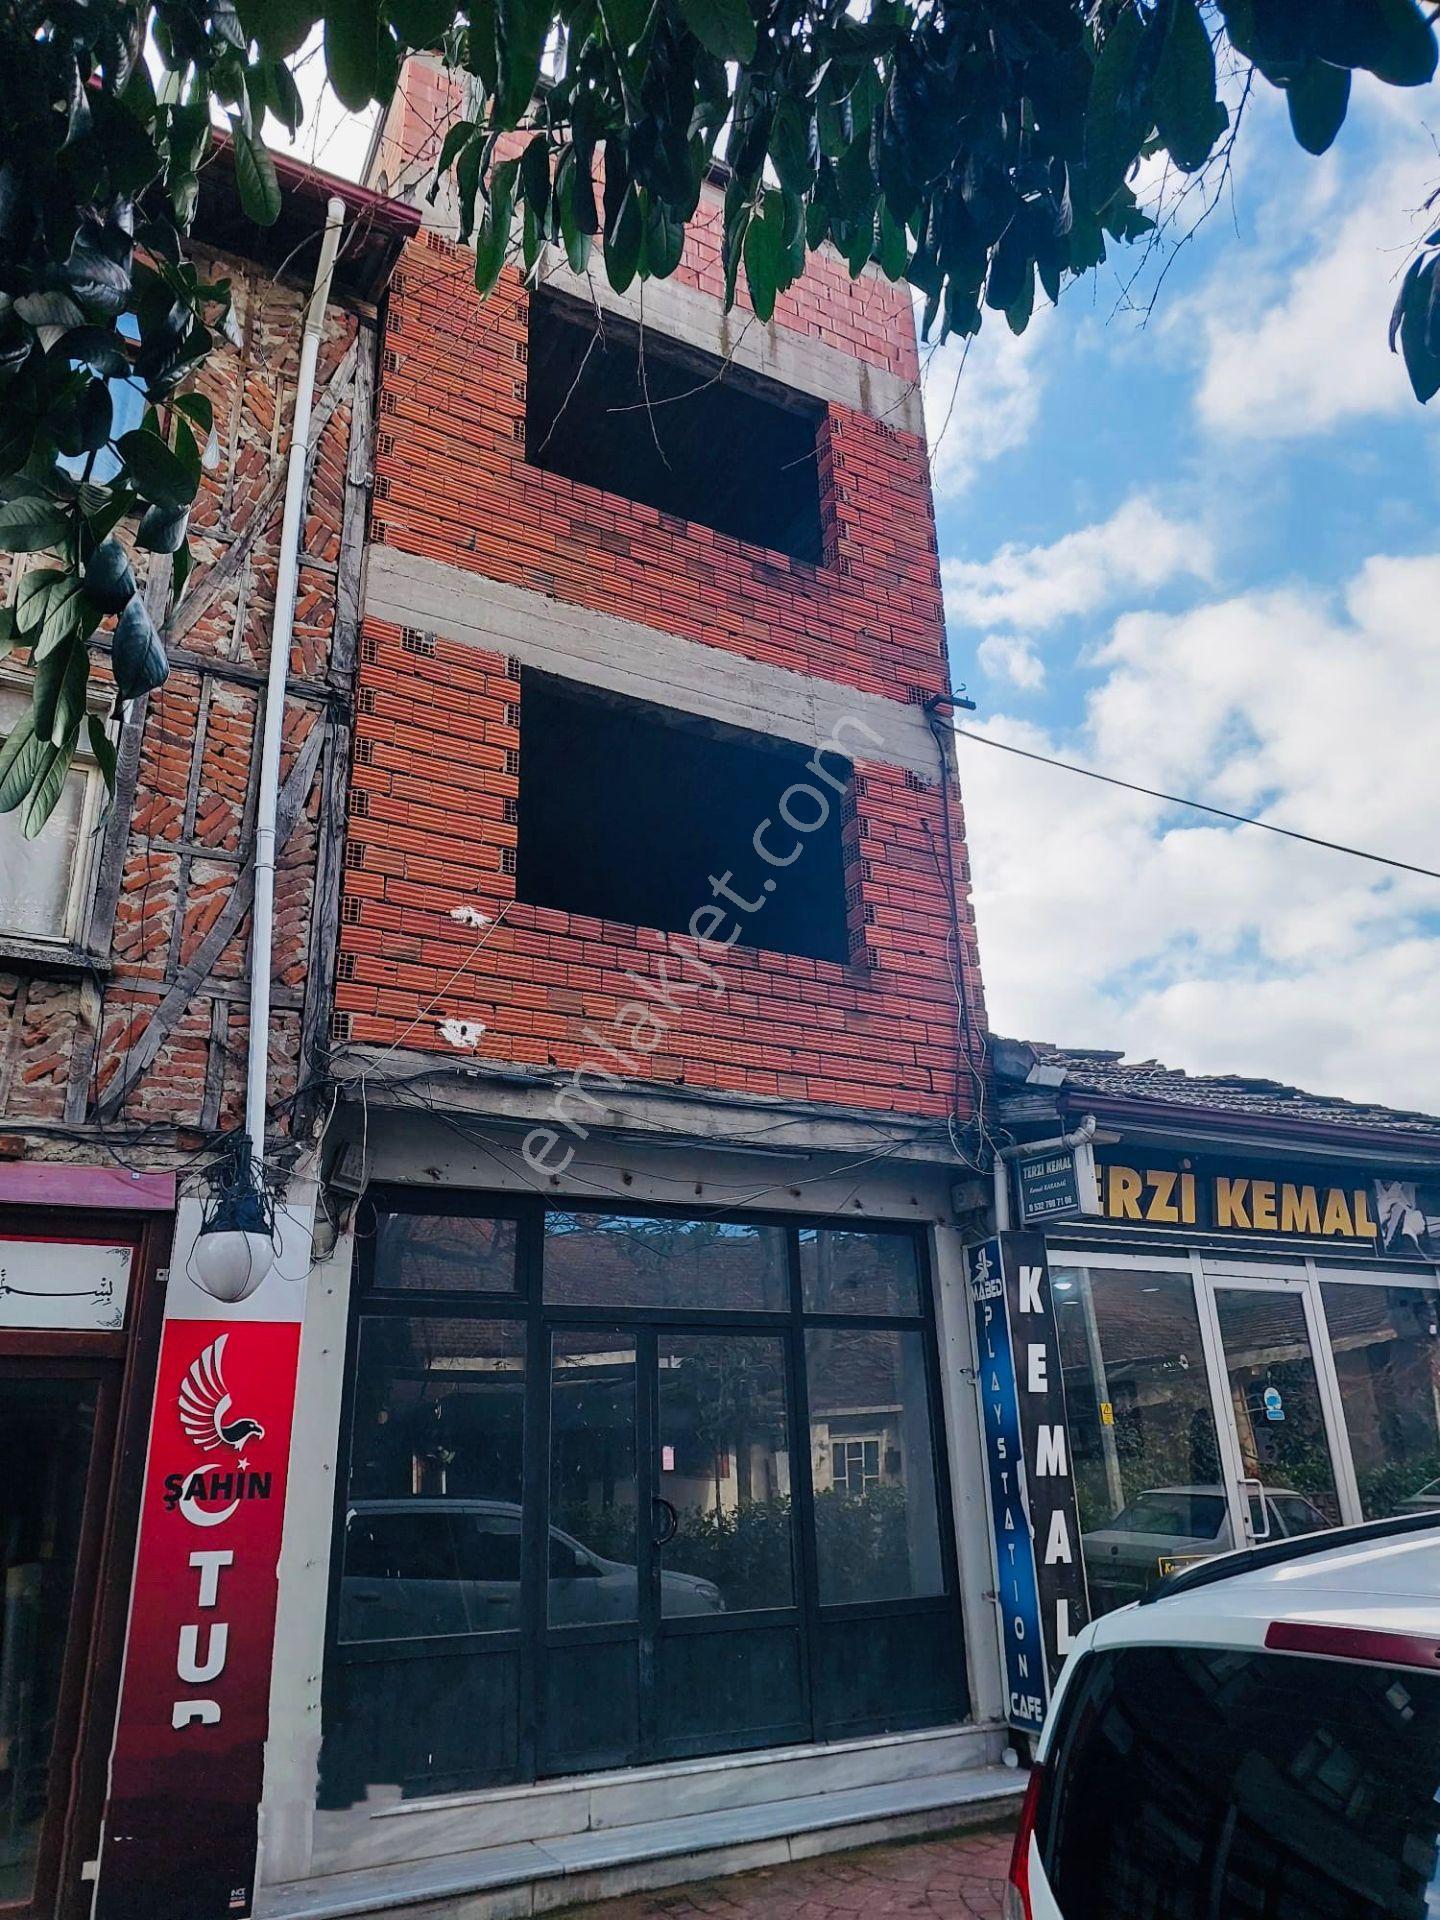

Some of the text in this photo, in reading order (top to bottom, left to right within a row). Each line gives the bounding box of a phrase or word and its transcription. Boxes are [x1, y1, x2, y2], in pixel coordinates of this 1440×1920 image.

[1045, 1157, 1072, 1174] KEMAL
[1216, 1176, 1377, 1238] KEMAL
[1019, 1265, 1077, 1655] KEMAL
[1010, 1692, 1044, 1723] CAFE
